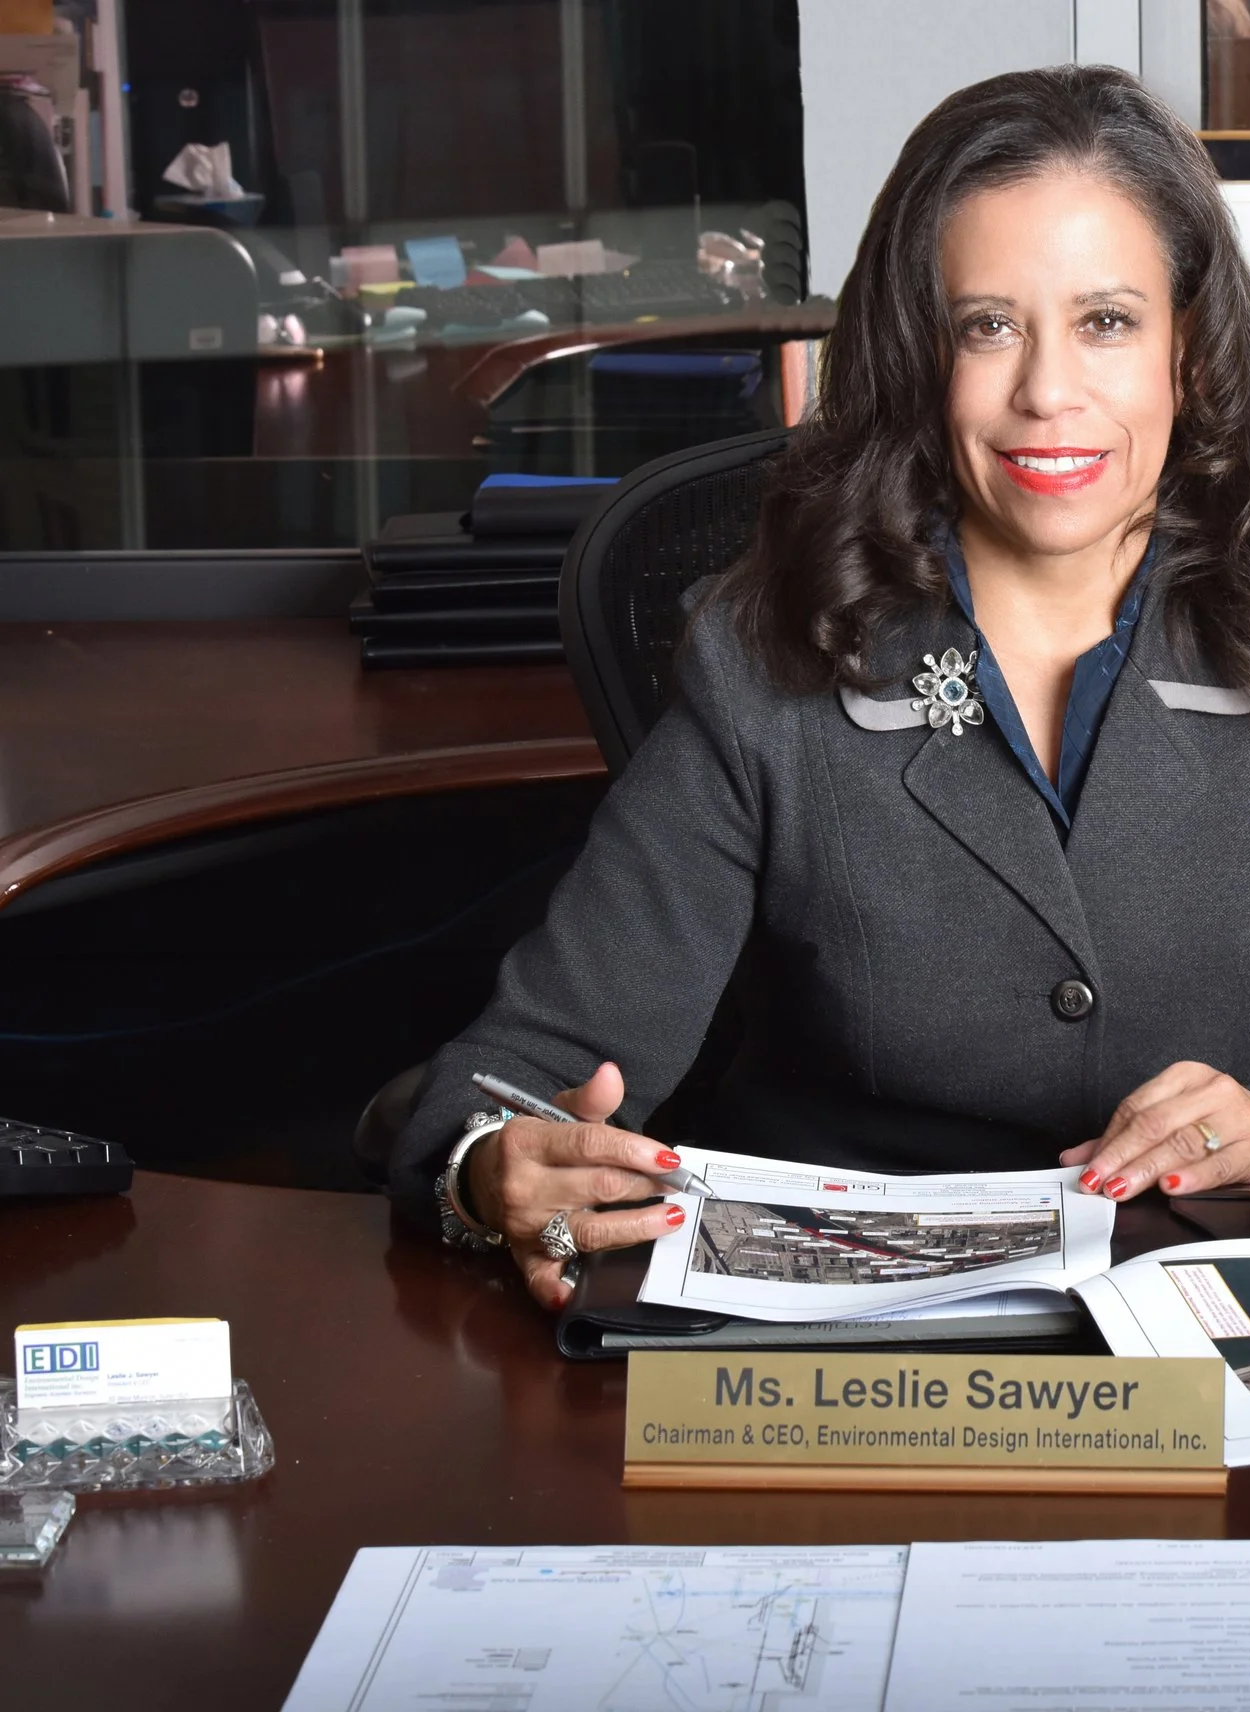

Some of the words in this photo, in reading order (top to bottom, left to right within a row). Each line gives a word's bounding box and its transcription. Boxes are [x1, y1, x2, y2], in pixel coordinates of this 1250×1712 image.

[526, 1101, 538, 1110] Jim
[542, 1108, 563, 1122] Mayor
[27, 1344, 97, 1372] EDI
[715, 1367, 794, 1407] Ms.
[814, 1368, 948, 1409] Leslie
[966, 1369, 1139, 1420] Sawyer
[643, 1422, 734, 1445] Chairman
[742, 1424, 754, 1445] &
[762, 1424, 809, 1449] CEO,
[817, 1425, 955, 1448] Environmental
[963, 1427, 1029, 1452] Design
[1036, 1427, 1164, 1453] International,
[1172, 1428, 1207, 1450] Inc.
